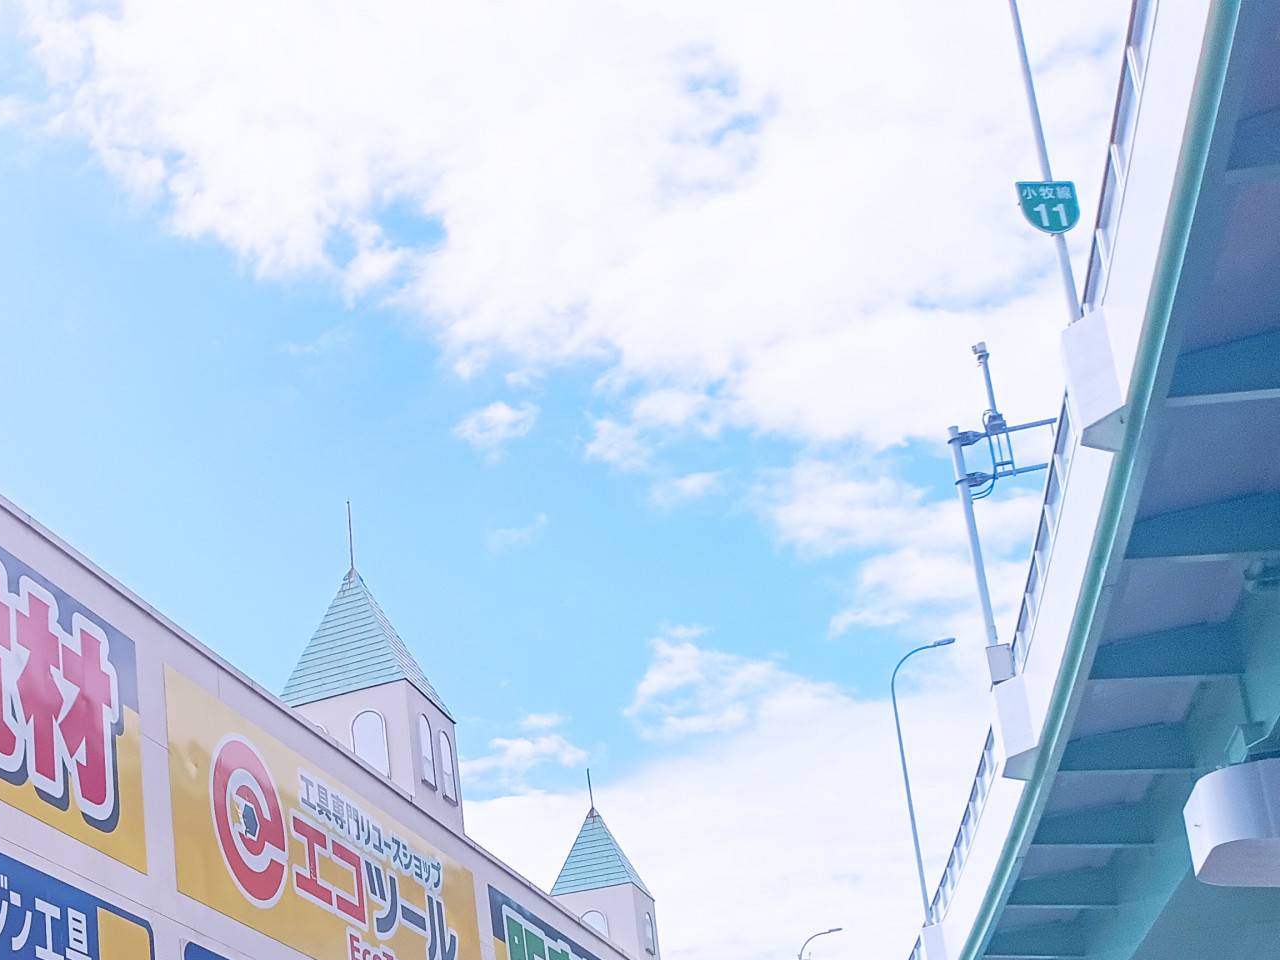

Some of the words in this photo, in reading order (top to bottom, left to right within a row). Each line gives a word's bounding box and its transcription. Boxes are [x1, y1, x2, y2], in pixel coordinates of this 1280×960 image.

[1033, 203, 1068, 226] 11
[300, 773, 442, 889] 工具専門リユースショップ
